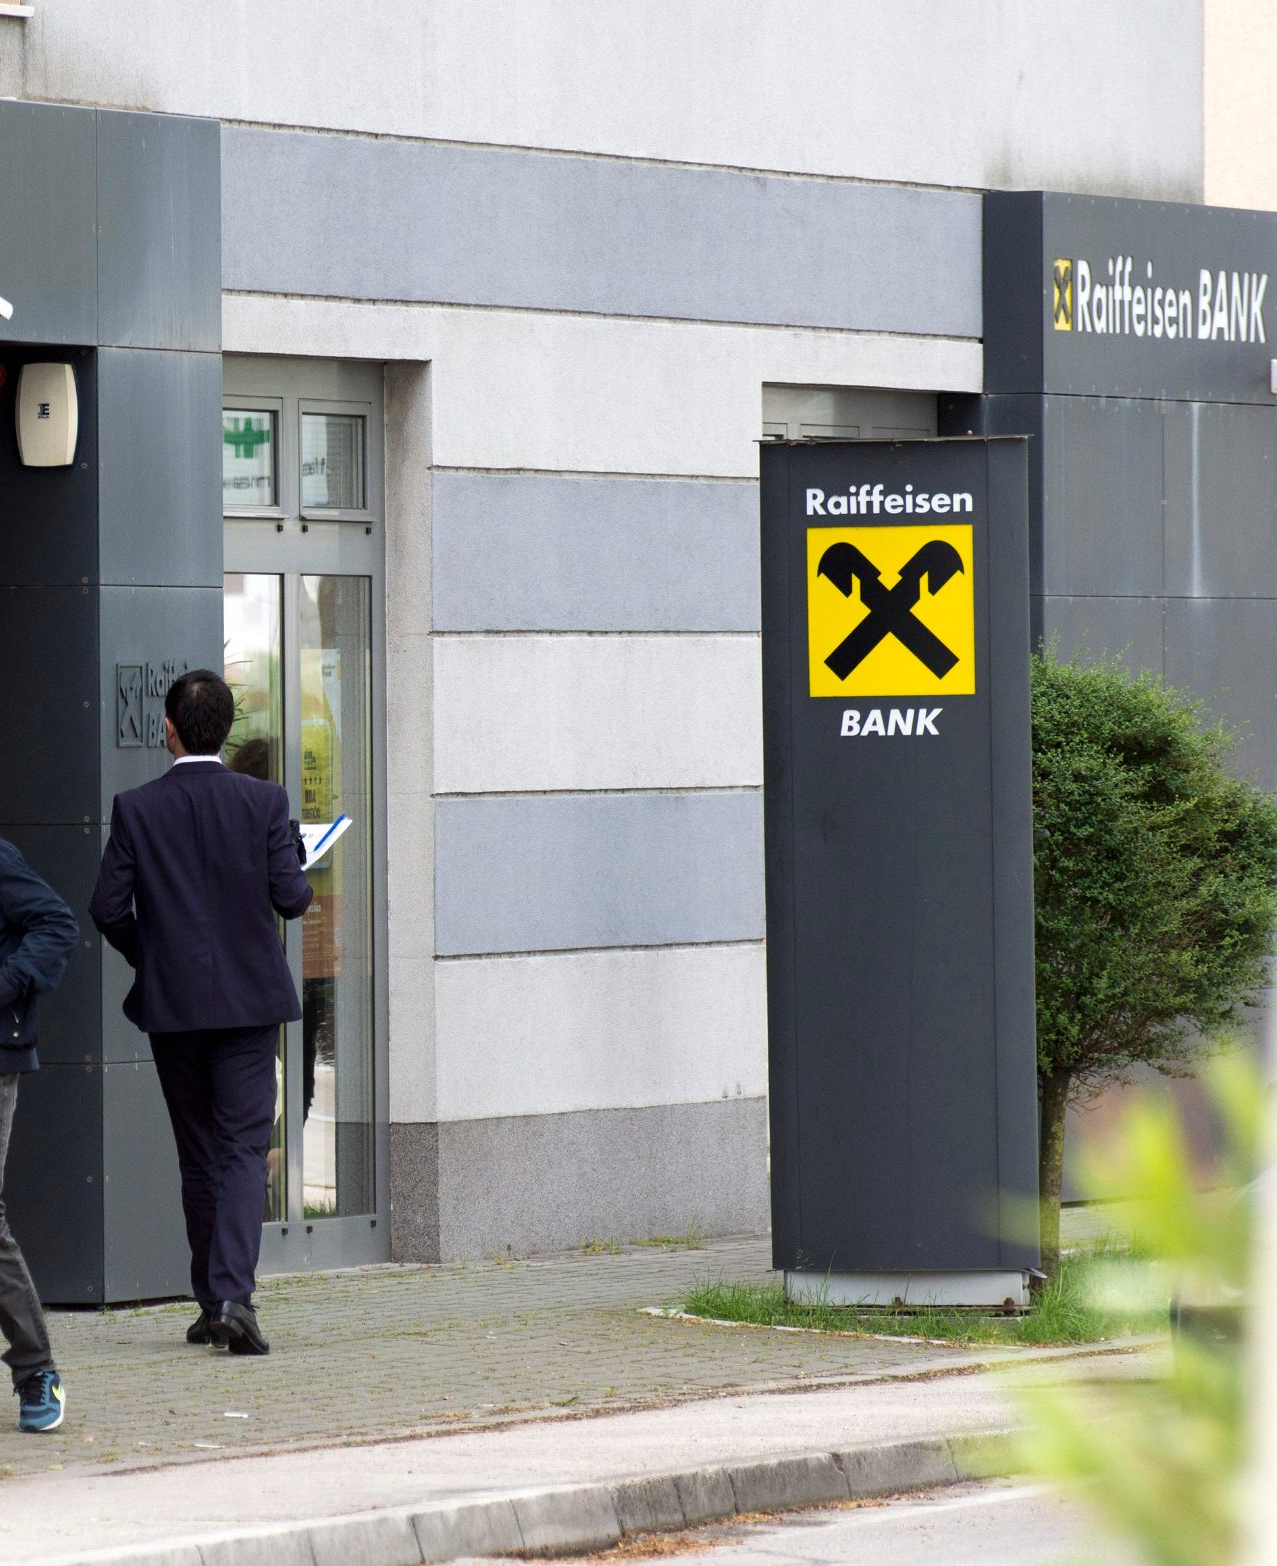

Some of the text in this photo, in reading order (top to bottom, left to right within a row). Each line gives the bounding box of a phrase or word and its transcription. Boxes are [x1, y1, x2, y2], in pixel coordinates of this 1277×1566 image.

[1077, 255, 1268, 343] Raiffeisen BANK
[805, 483, 973, 516] Raiffeisen
[840, 708, 943, 737] BANK
